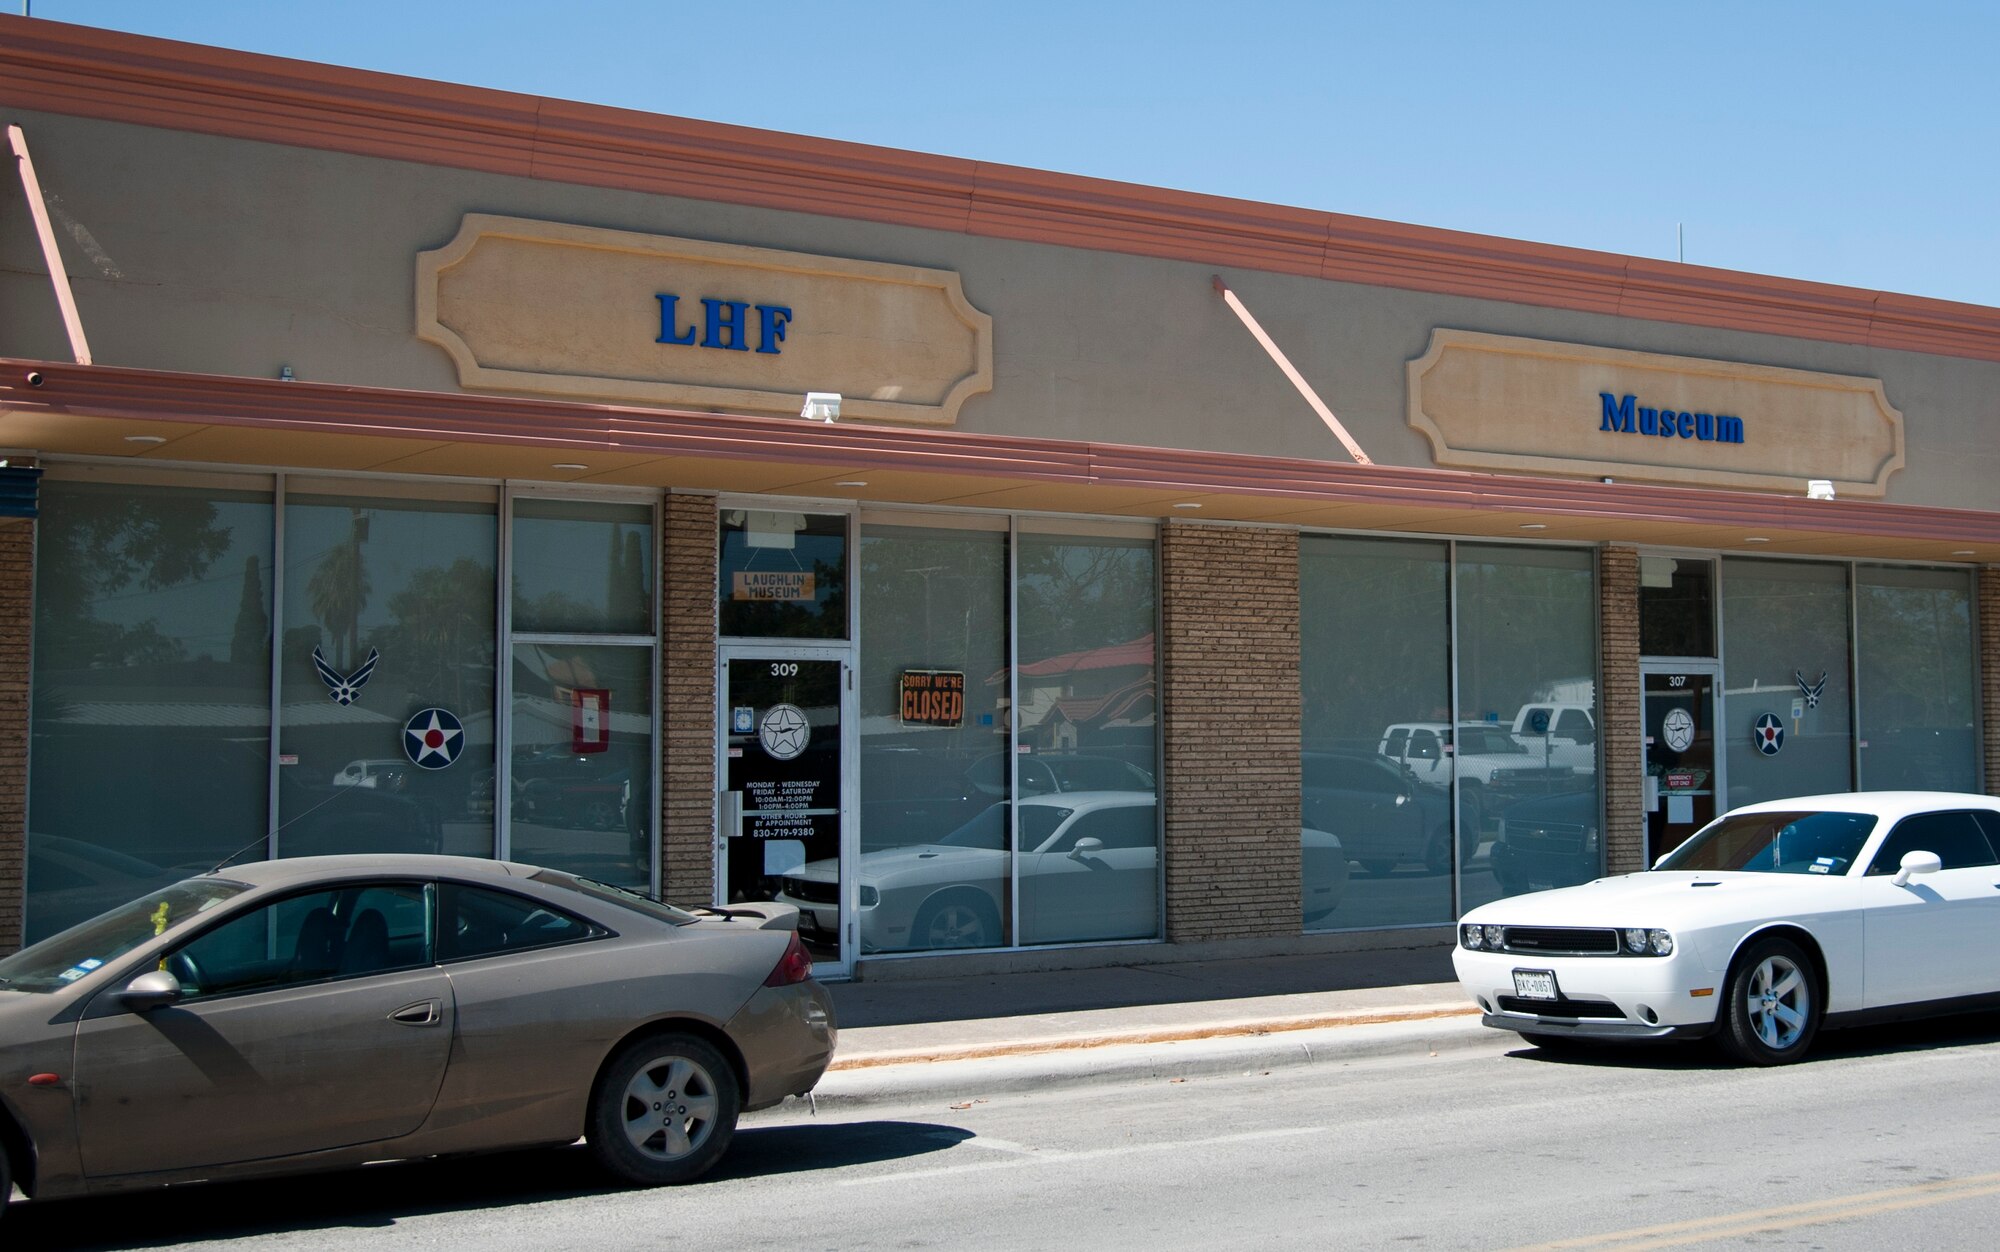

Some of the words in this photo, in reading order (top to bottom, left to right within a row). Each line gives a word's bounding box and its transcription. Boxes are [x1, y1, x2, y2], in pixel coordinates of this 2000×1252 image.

[655, 294, 792, 354] LHF
[1599, 392, 1745, 444] Museum
[744, 574, 805, 586] LAUGHLIN
[749, 587, 800, 598] MUSEUM
[771, 663, 798, 676] 309
[904, 675, 932, 687] SORRY
[935, 676, 962, 688] WE'RE
[1669, 676, 1686, 687] 307
[903, 690, 962, 720] CLOSED
[765, 819, 812, 827] APPOINTMENT
[753, 828, 815, 838] 830-719-9380
